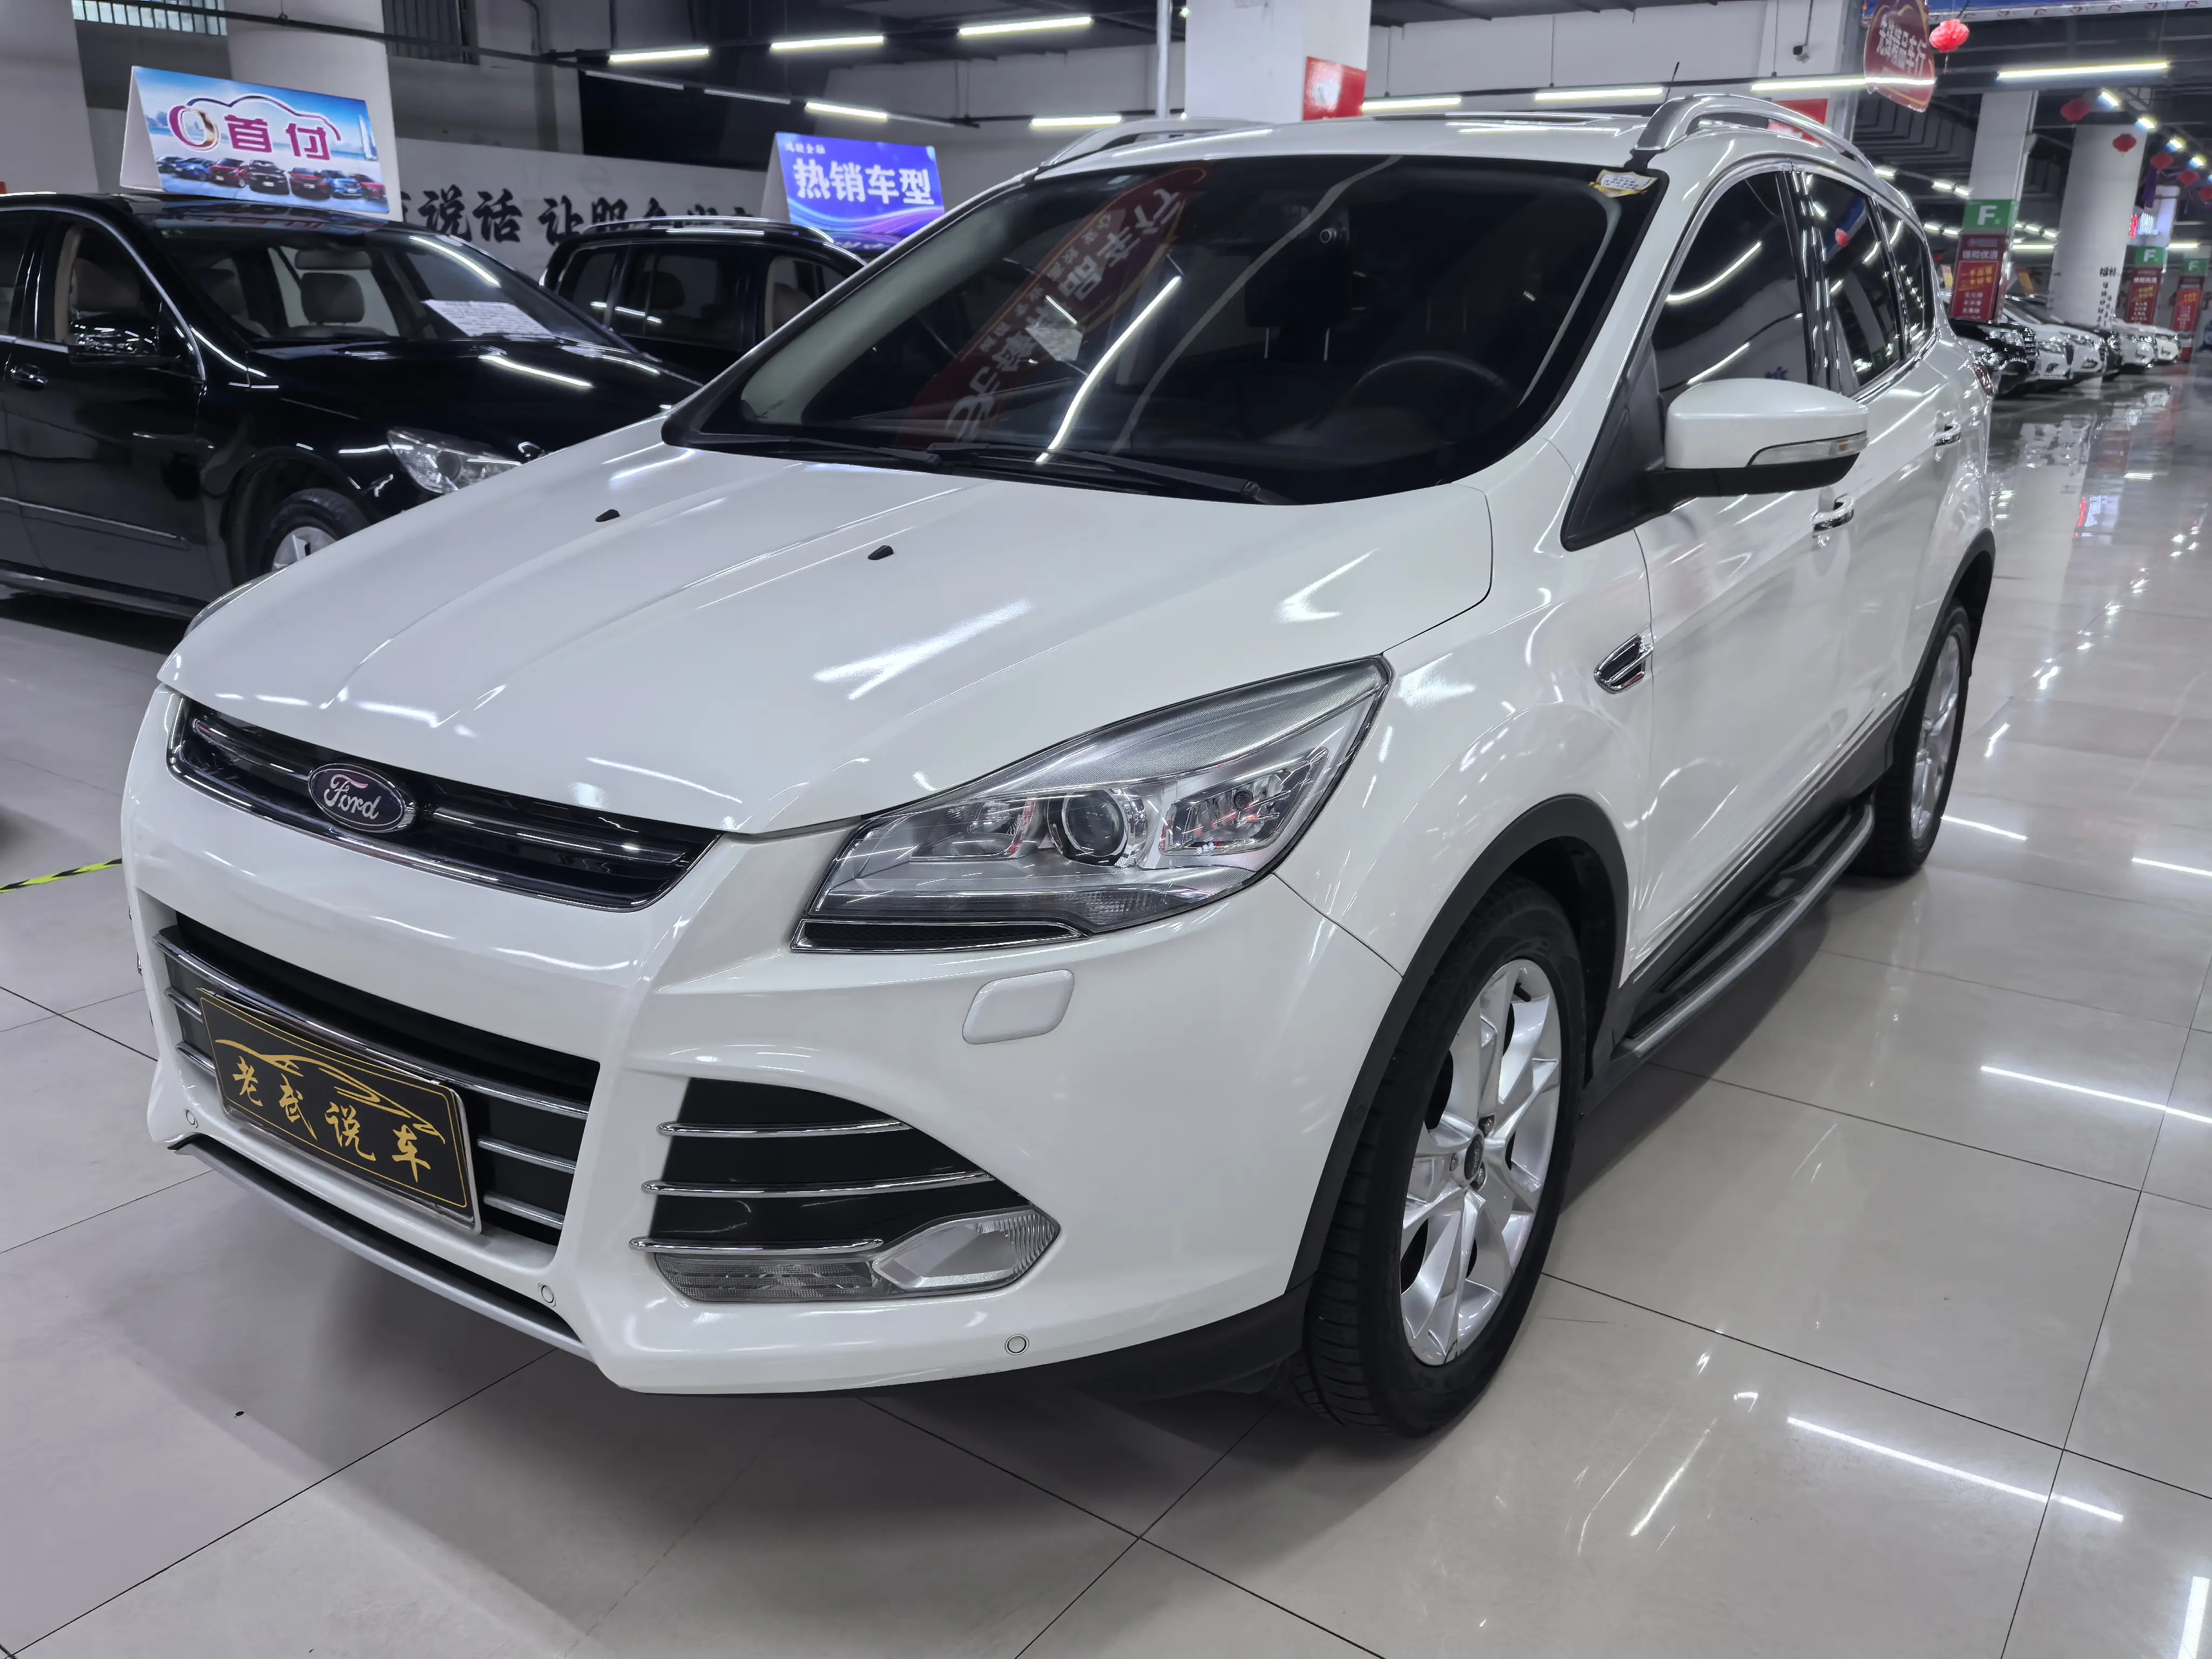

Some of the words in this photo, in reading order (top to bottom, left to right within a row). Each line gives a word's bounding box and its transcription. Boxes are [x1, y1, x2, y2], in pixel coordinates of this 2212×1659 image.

[792, 157, 935, 206] 热销车型
[323, 773, 382, 820] Ford
